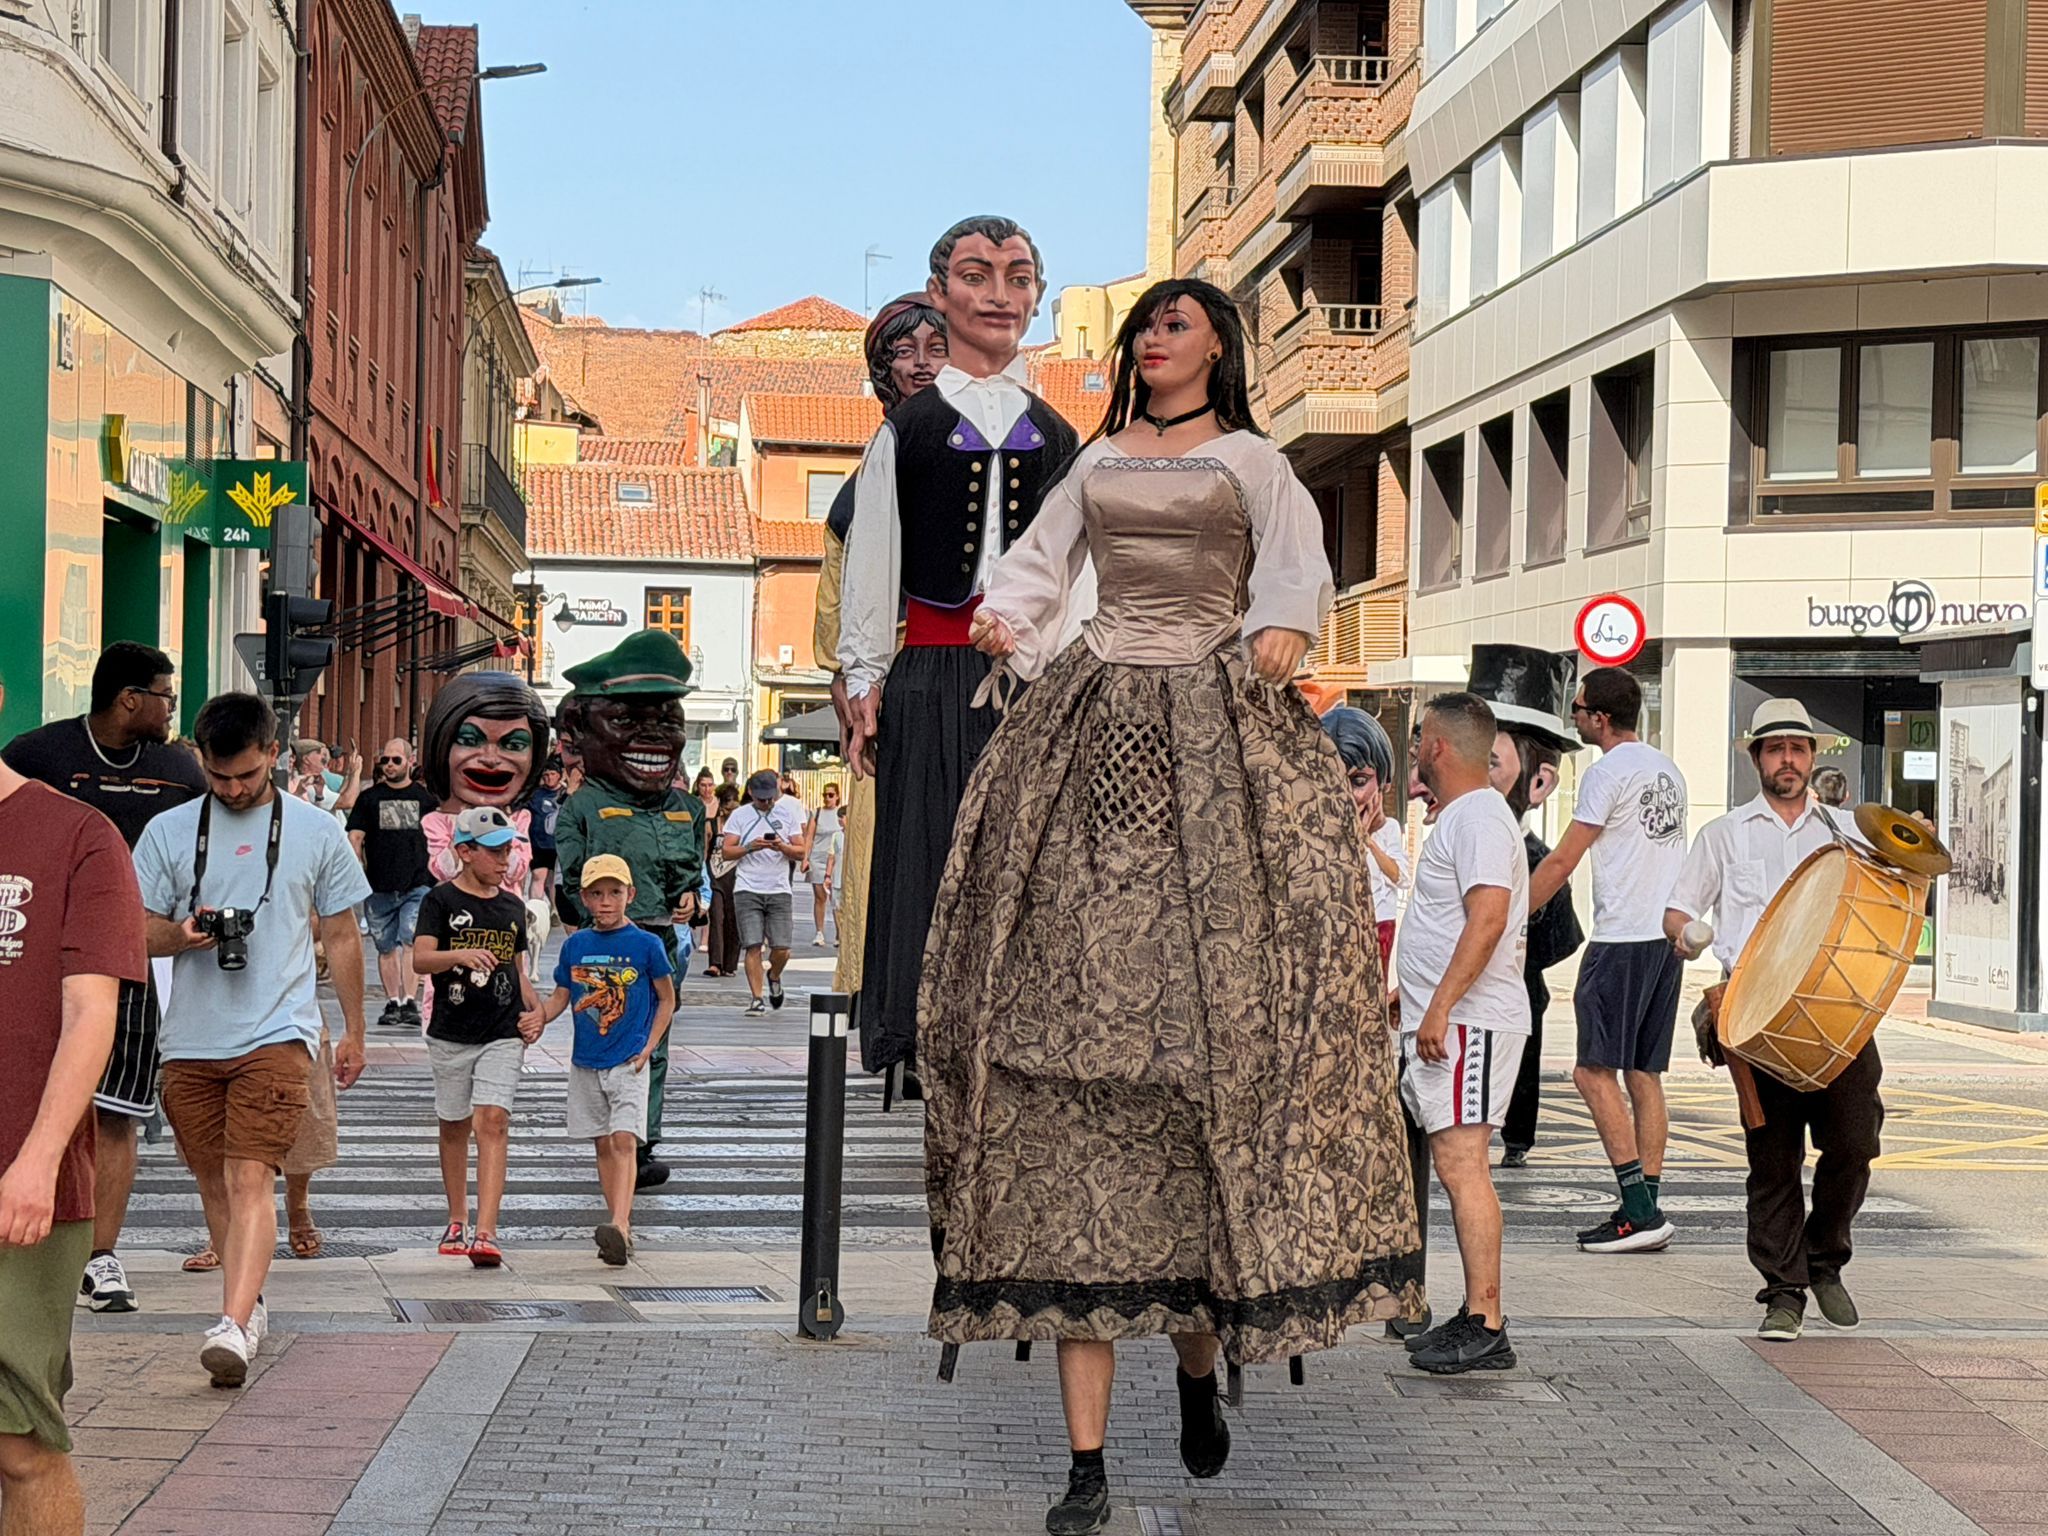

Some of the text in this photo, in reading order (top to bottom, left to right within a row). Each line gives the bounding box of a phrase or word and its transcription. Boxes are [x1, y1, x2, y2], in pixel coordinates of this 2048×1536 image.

[223, 527, 250, 542] 24h
[1808, 596, 1886, 636] burgo
[1940, 603, 2027, 626] nuevo
[450, 928, 516, 951] STAR
